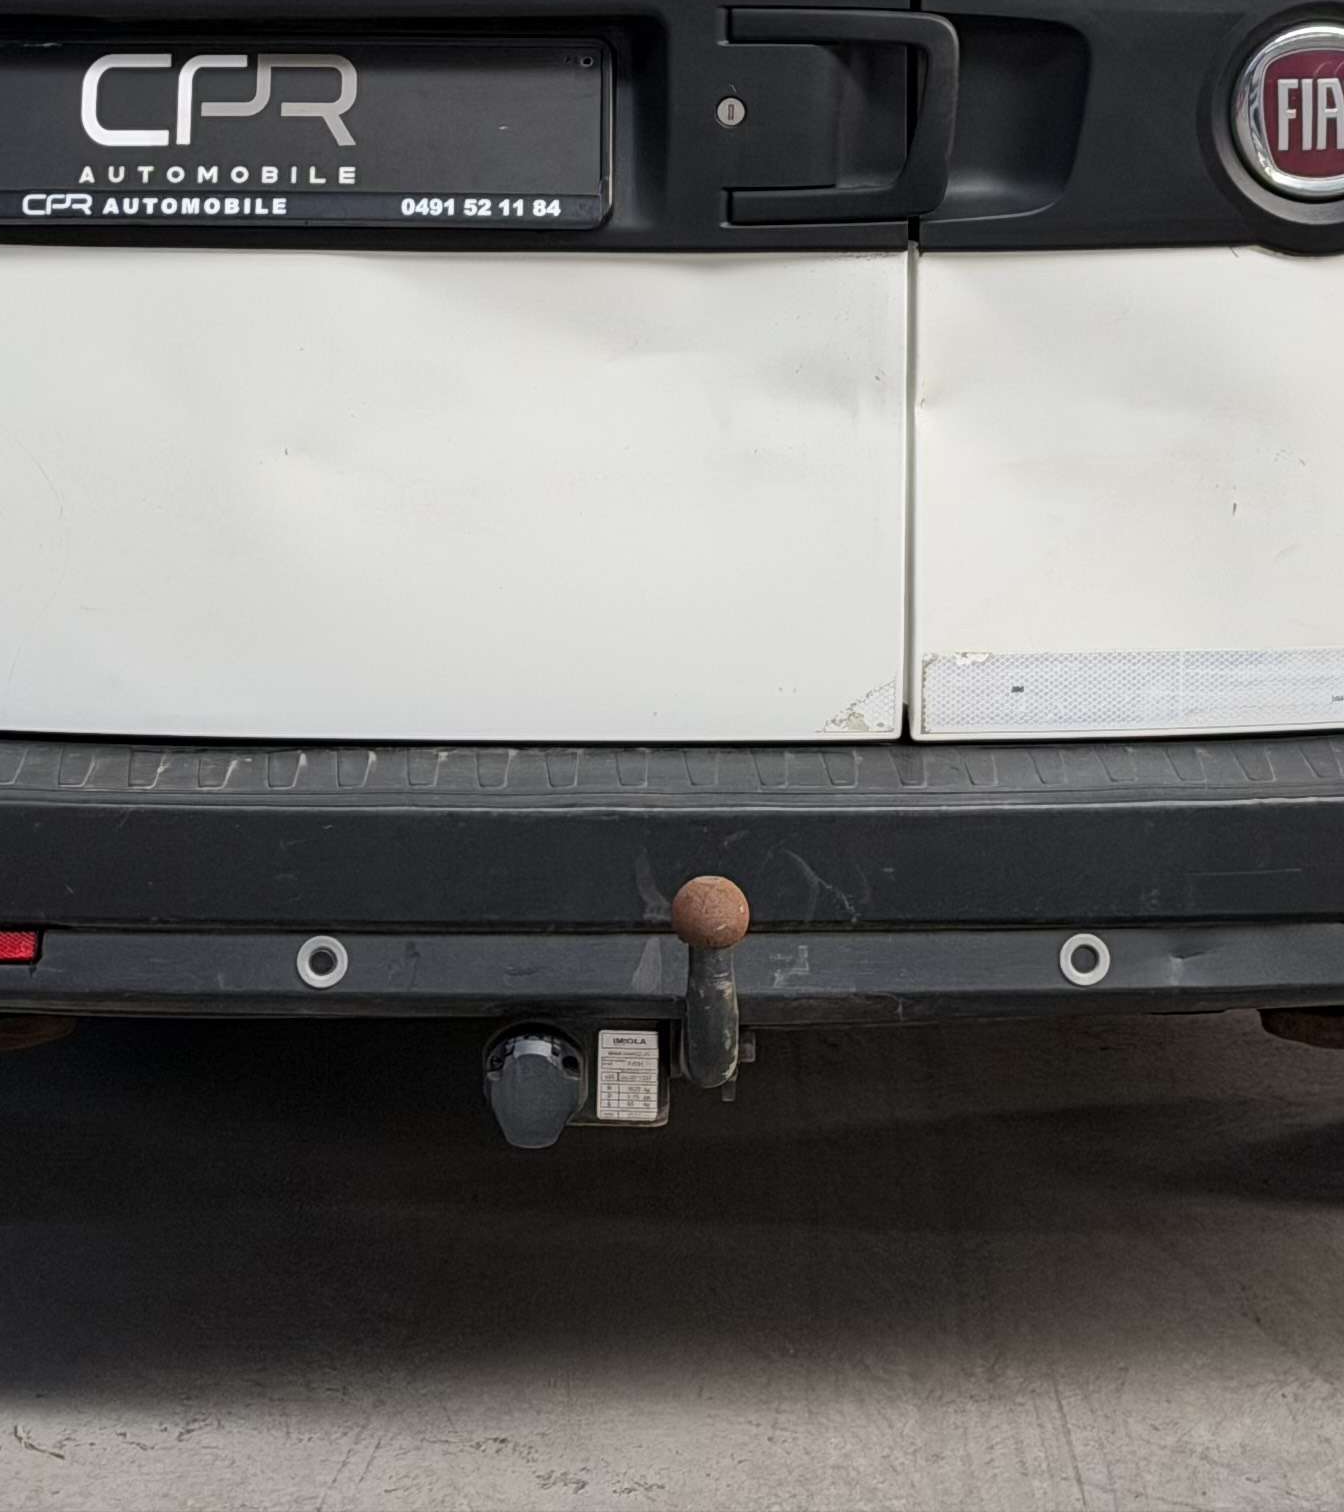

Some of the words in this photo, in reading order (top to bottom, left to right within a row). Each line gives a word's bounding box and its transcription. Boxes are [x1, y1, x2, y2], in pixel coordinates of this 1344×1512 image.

[80, 53, 357, 146] CPR
[78, 165, 357, 184] AUTOMOBILE
[22, 193, 93, 216] CPR
[103, 197, 288, 215] AUTOMOBILE
[400, 197, 455, 216] 0491
[463, 198, 492, 217] 52
[498, 199, 524, 217] 11
[532, 199, 561, 217] 84
